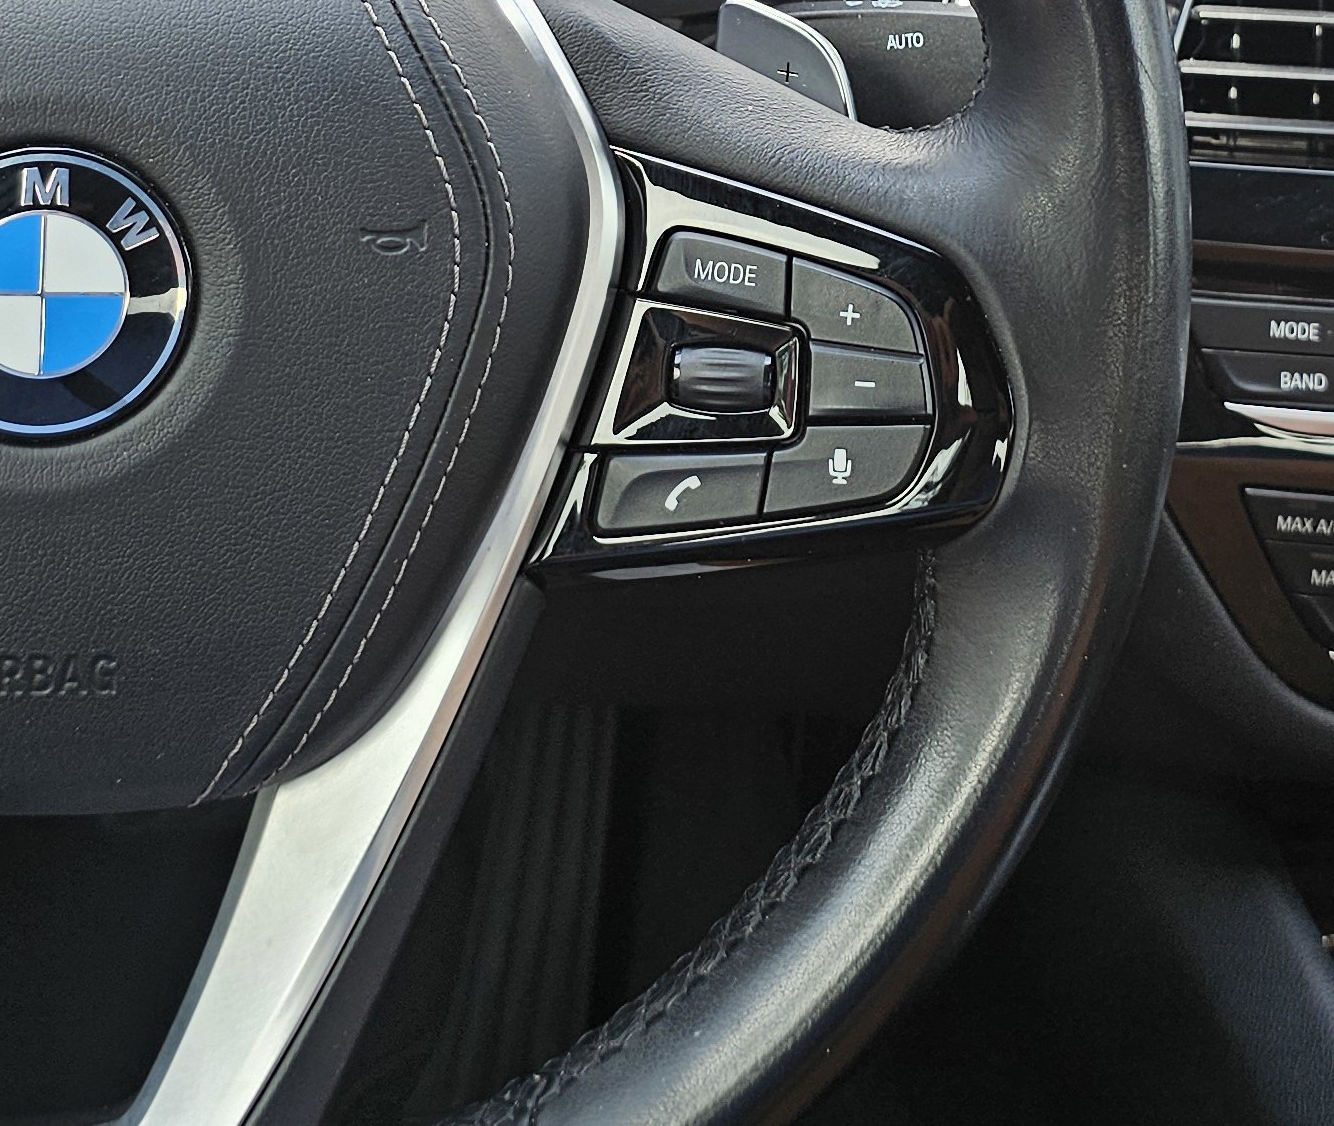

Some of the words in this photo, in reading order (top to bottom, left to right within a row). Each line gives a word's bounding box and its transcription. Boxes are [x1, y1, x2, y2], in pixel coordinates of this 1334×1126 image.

[886, 32, 925, 51] AUTO
[693, 257, 758, 287] MODE
[1269, 319, 1321, 342] MODE
[1280, 372, 1328, 393] BAND
[1276, 515, 1313, 534] MAX
